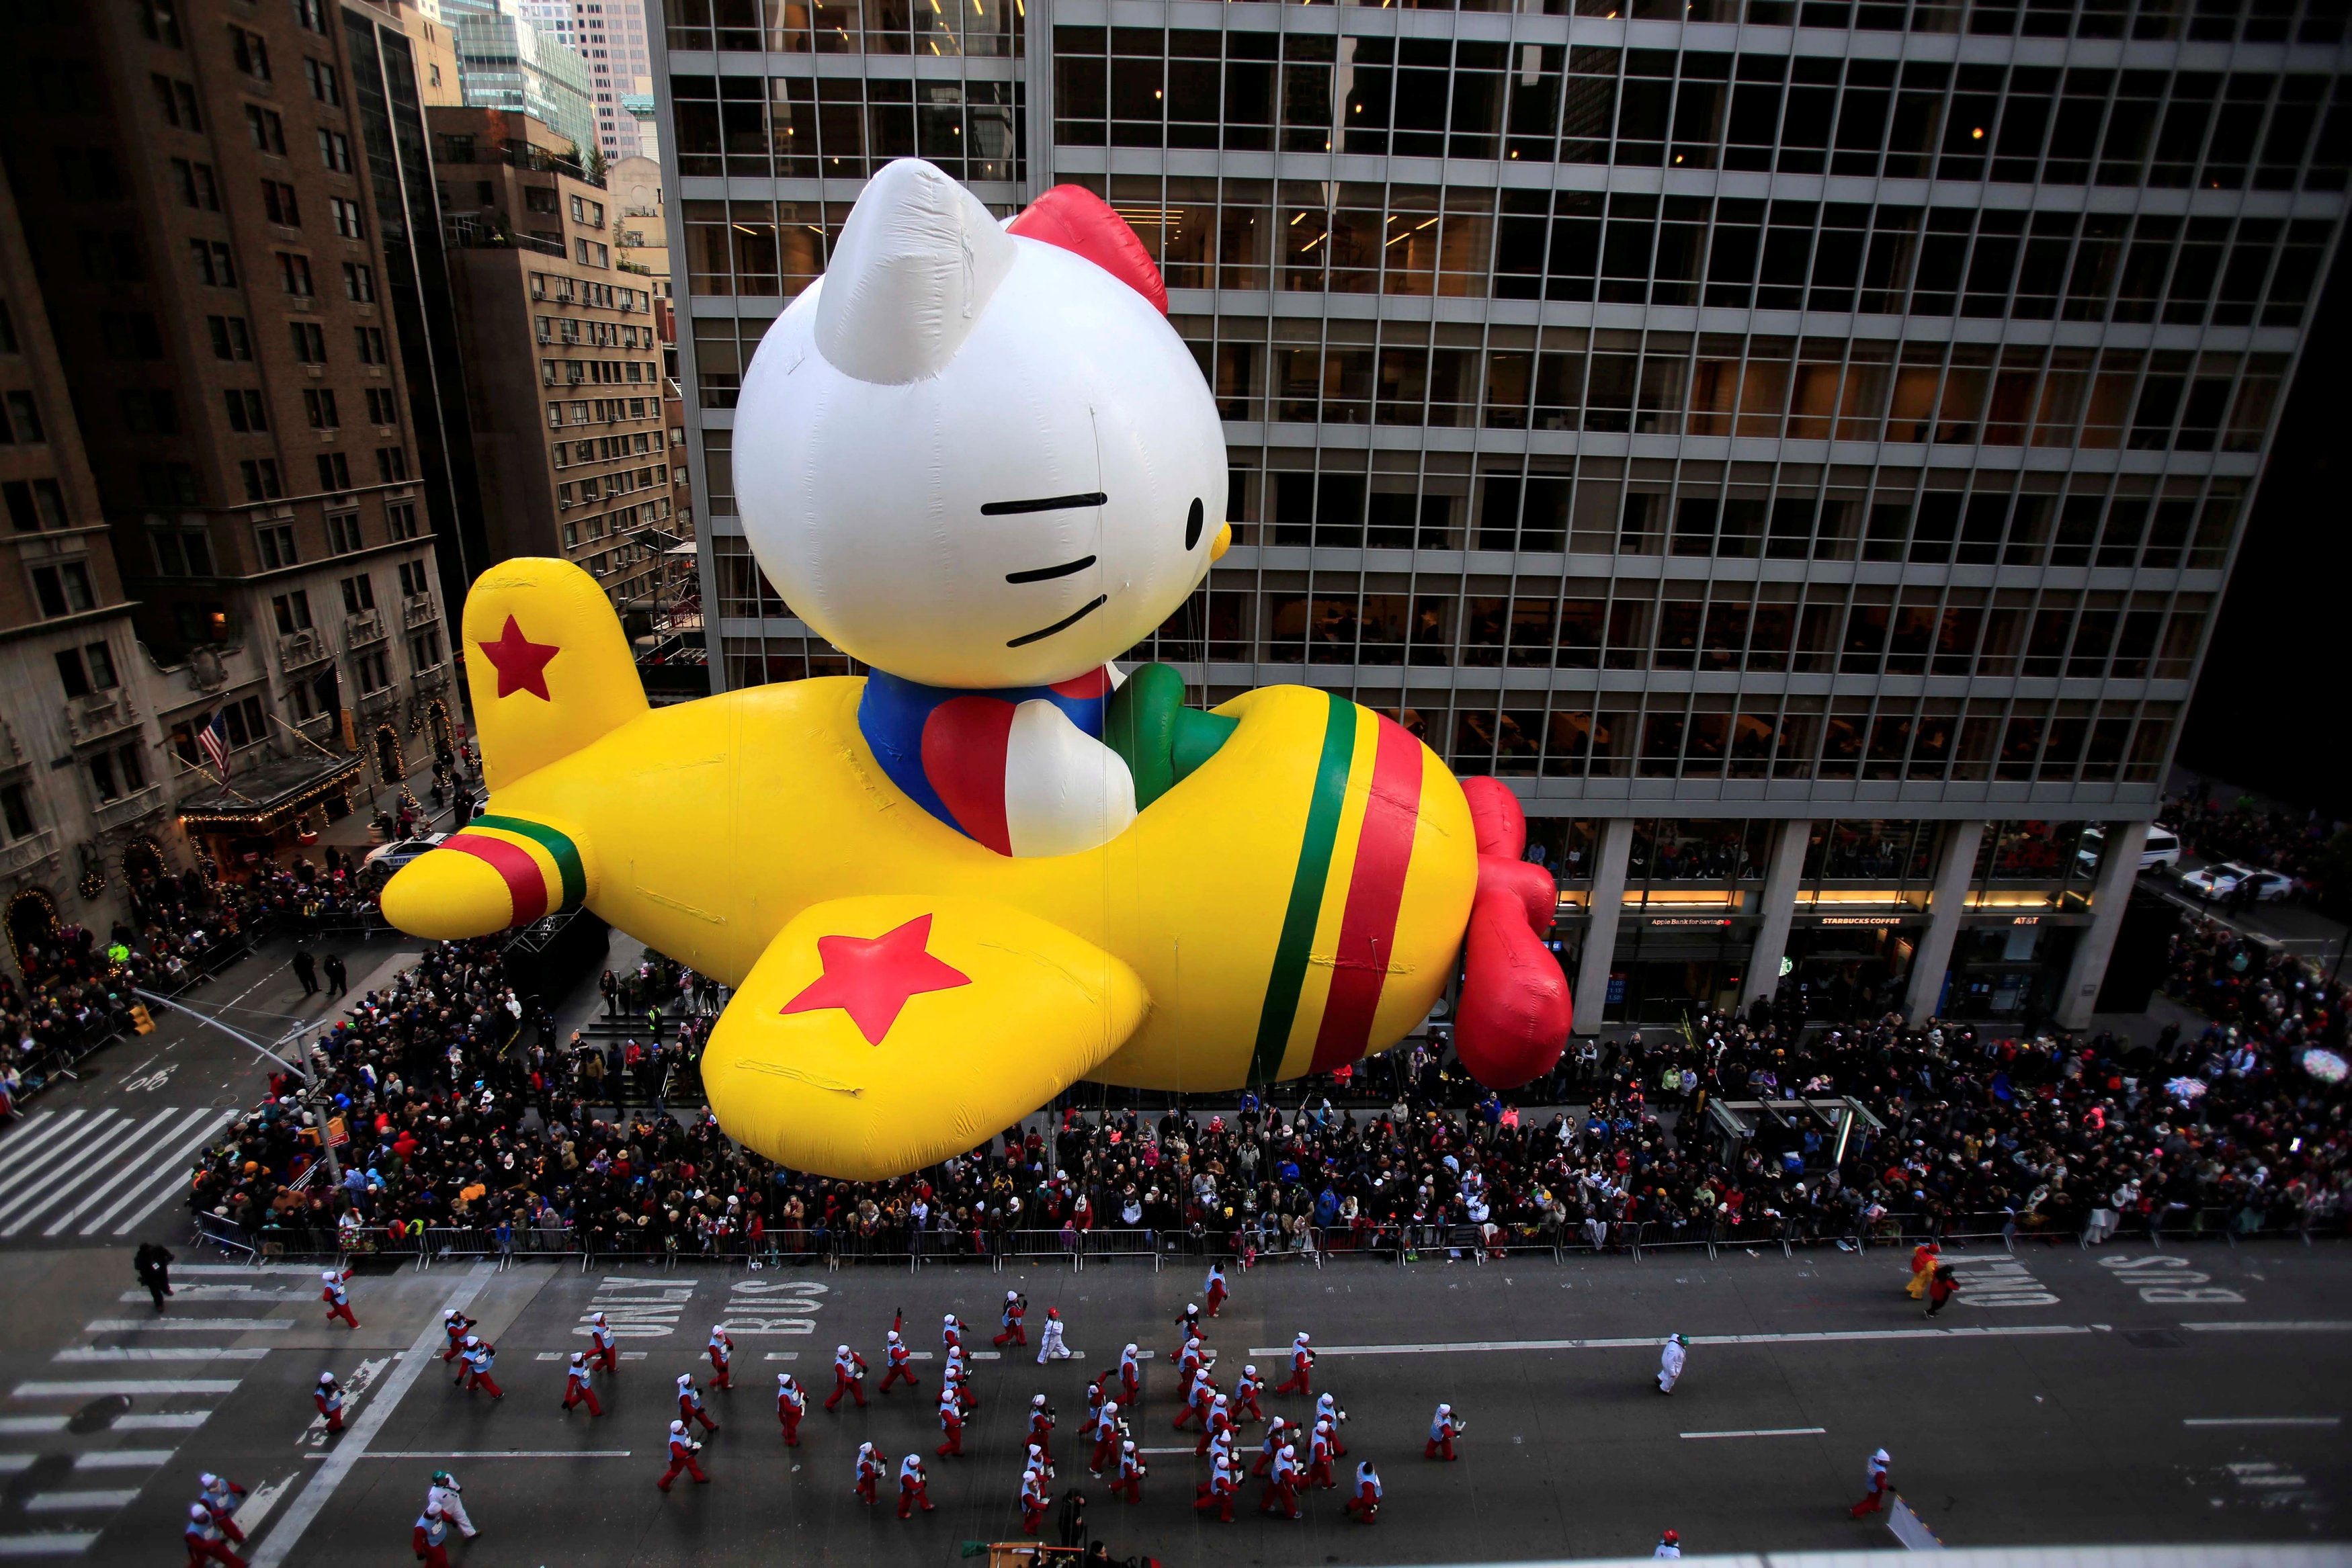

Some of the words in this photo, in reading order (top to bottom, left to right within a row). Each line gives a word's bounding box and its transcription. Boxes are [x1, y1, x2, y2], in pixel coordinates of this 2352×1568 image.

[572, 1276, 699, 1337] ONLY
[2097, 1255, 2246, 1303] BUS
[722, 1280, 829, 1335] BUS
